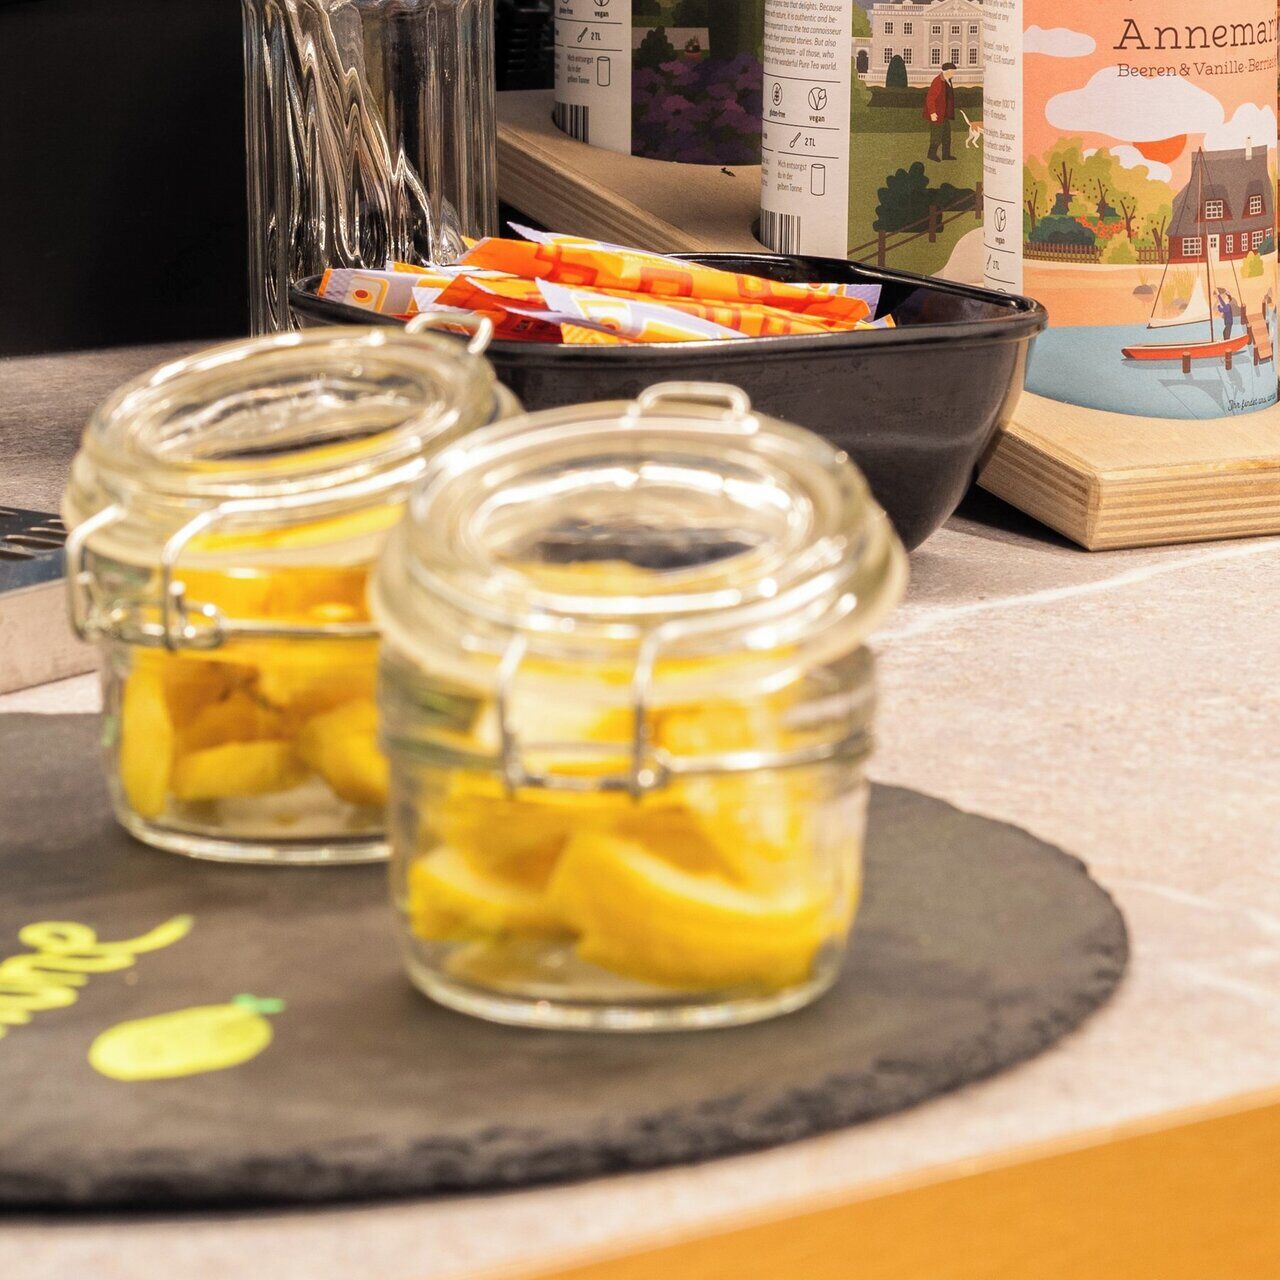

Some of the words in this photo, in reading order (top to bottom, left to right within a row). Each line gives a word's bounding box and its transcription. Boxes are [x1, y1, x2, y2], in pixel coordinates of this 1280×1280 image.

[819, 2, 843, 12] Because
[594, 10, 609, 18] vegan
[810, 26, 842, 36] connoisseur
[814, 37, 824, 47] But
[824, 38, 837, 47] also
[822, 50, 835, 59] who
[1117, 63, 1177, 78] Beeren
[1178, 63, 1191, 77] &
[809, 115, 826, 123] vegan
